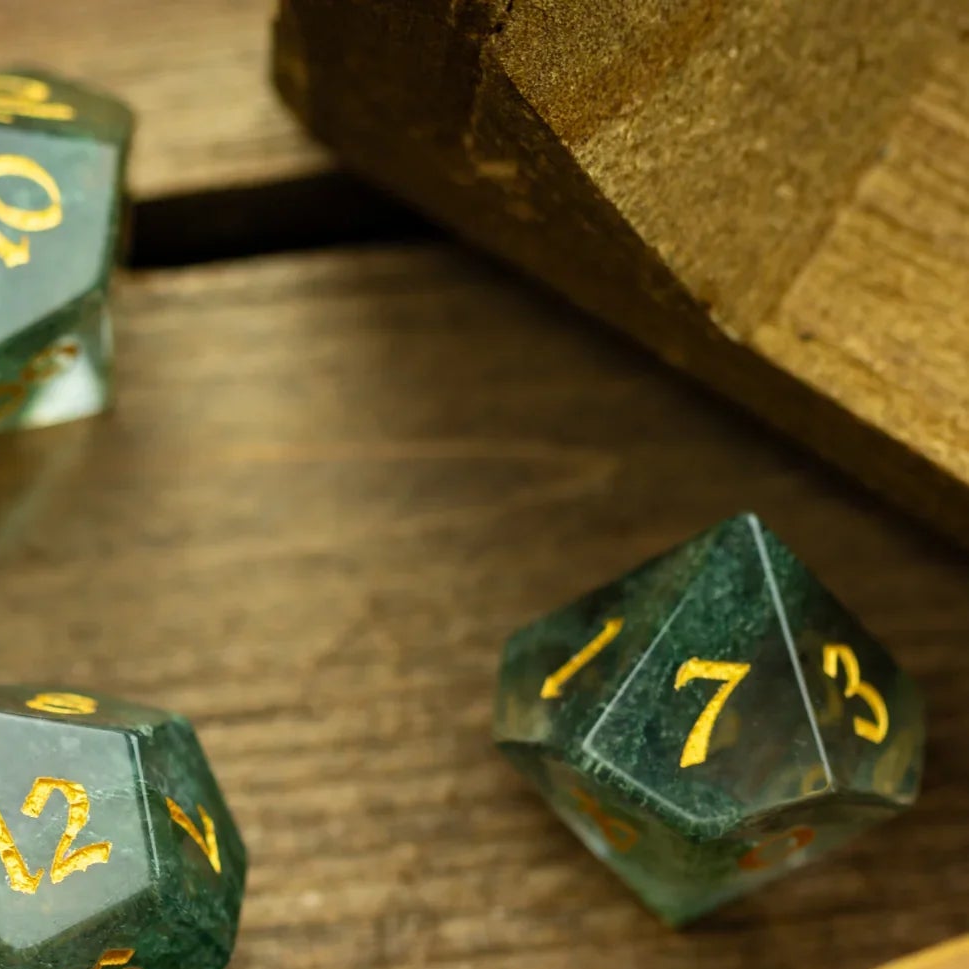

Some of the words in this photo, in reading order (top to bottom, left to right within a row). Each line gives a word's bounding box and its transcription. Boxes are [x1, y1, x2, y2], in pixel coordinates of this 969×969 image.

[540, 617, 624, 699] 1
[823, 644, 888, 744] 3
[674, 657, 751, 768] 7
